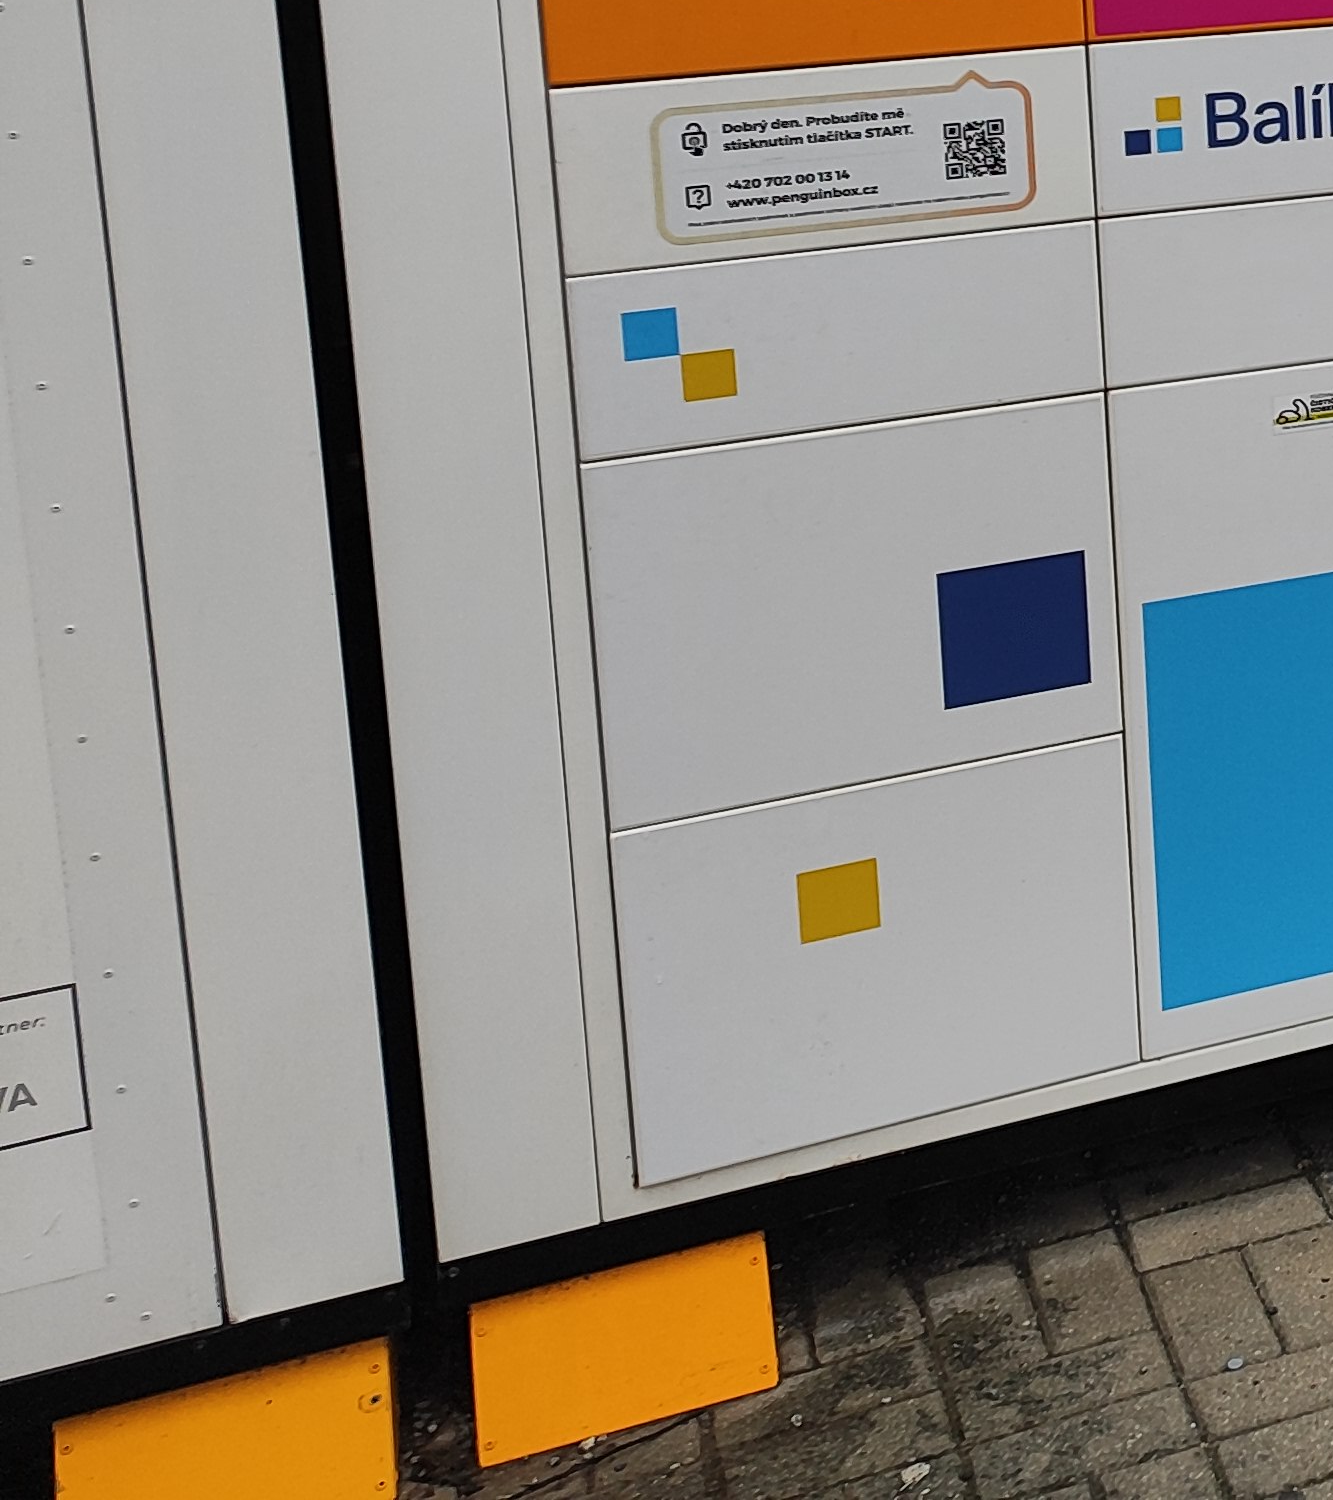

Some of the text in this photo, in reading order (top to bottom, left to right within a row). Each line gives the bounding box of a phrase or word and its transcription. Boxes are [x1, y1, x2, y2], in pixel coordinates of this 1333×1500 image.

[722, 120, 767, 133] Dobrý
[771, 118, 803, 130] den.
[723, 135, 803, 151] stisknutím
[806, 130, 861, 144] tlačítka
[725, 169, 850, 190] +420 702 00 13 14
[727, 185, 878, 208] www.penguinbox.cz
